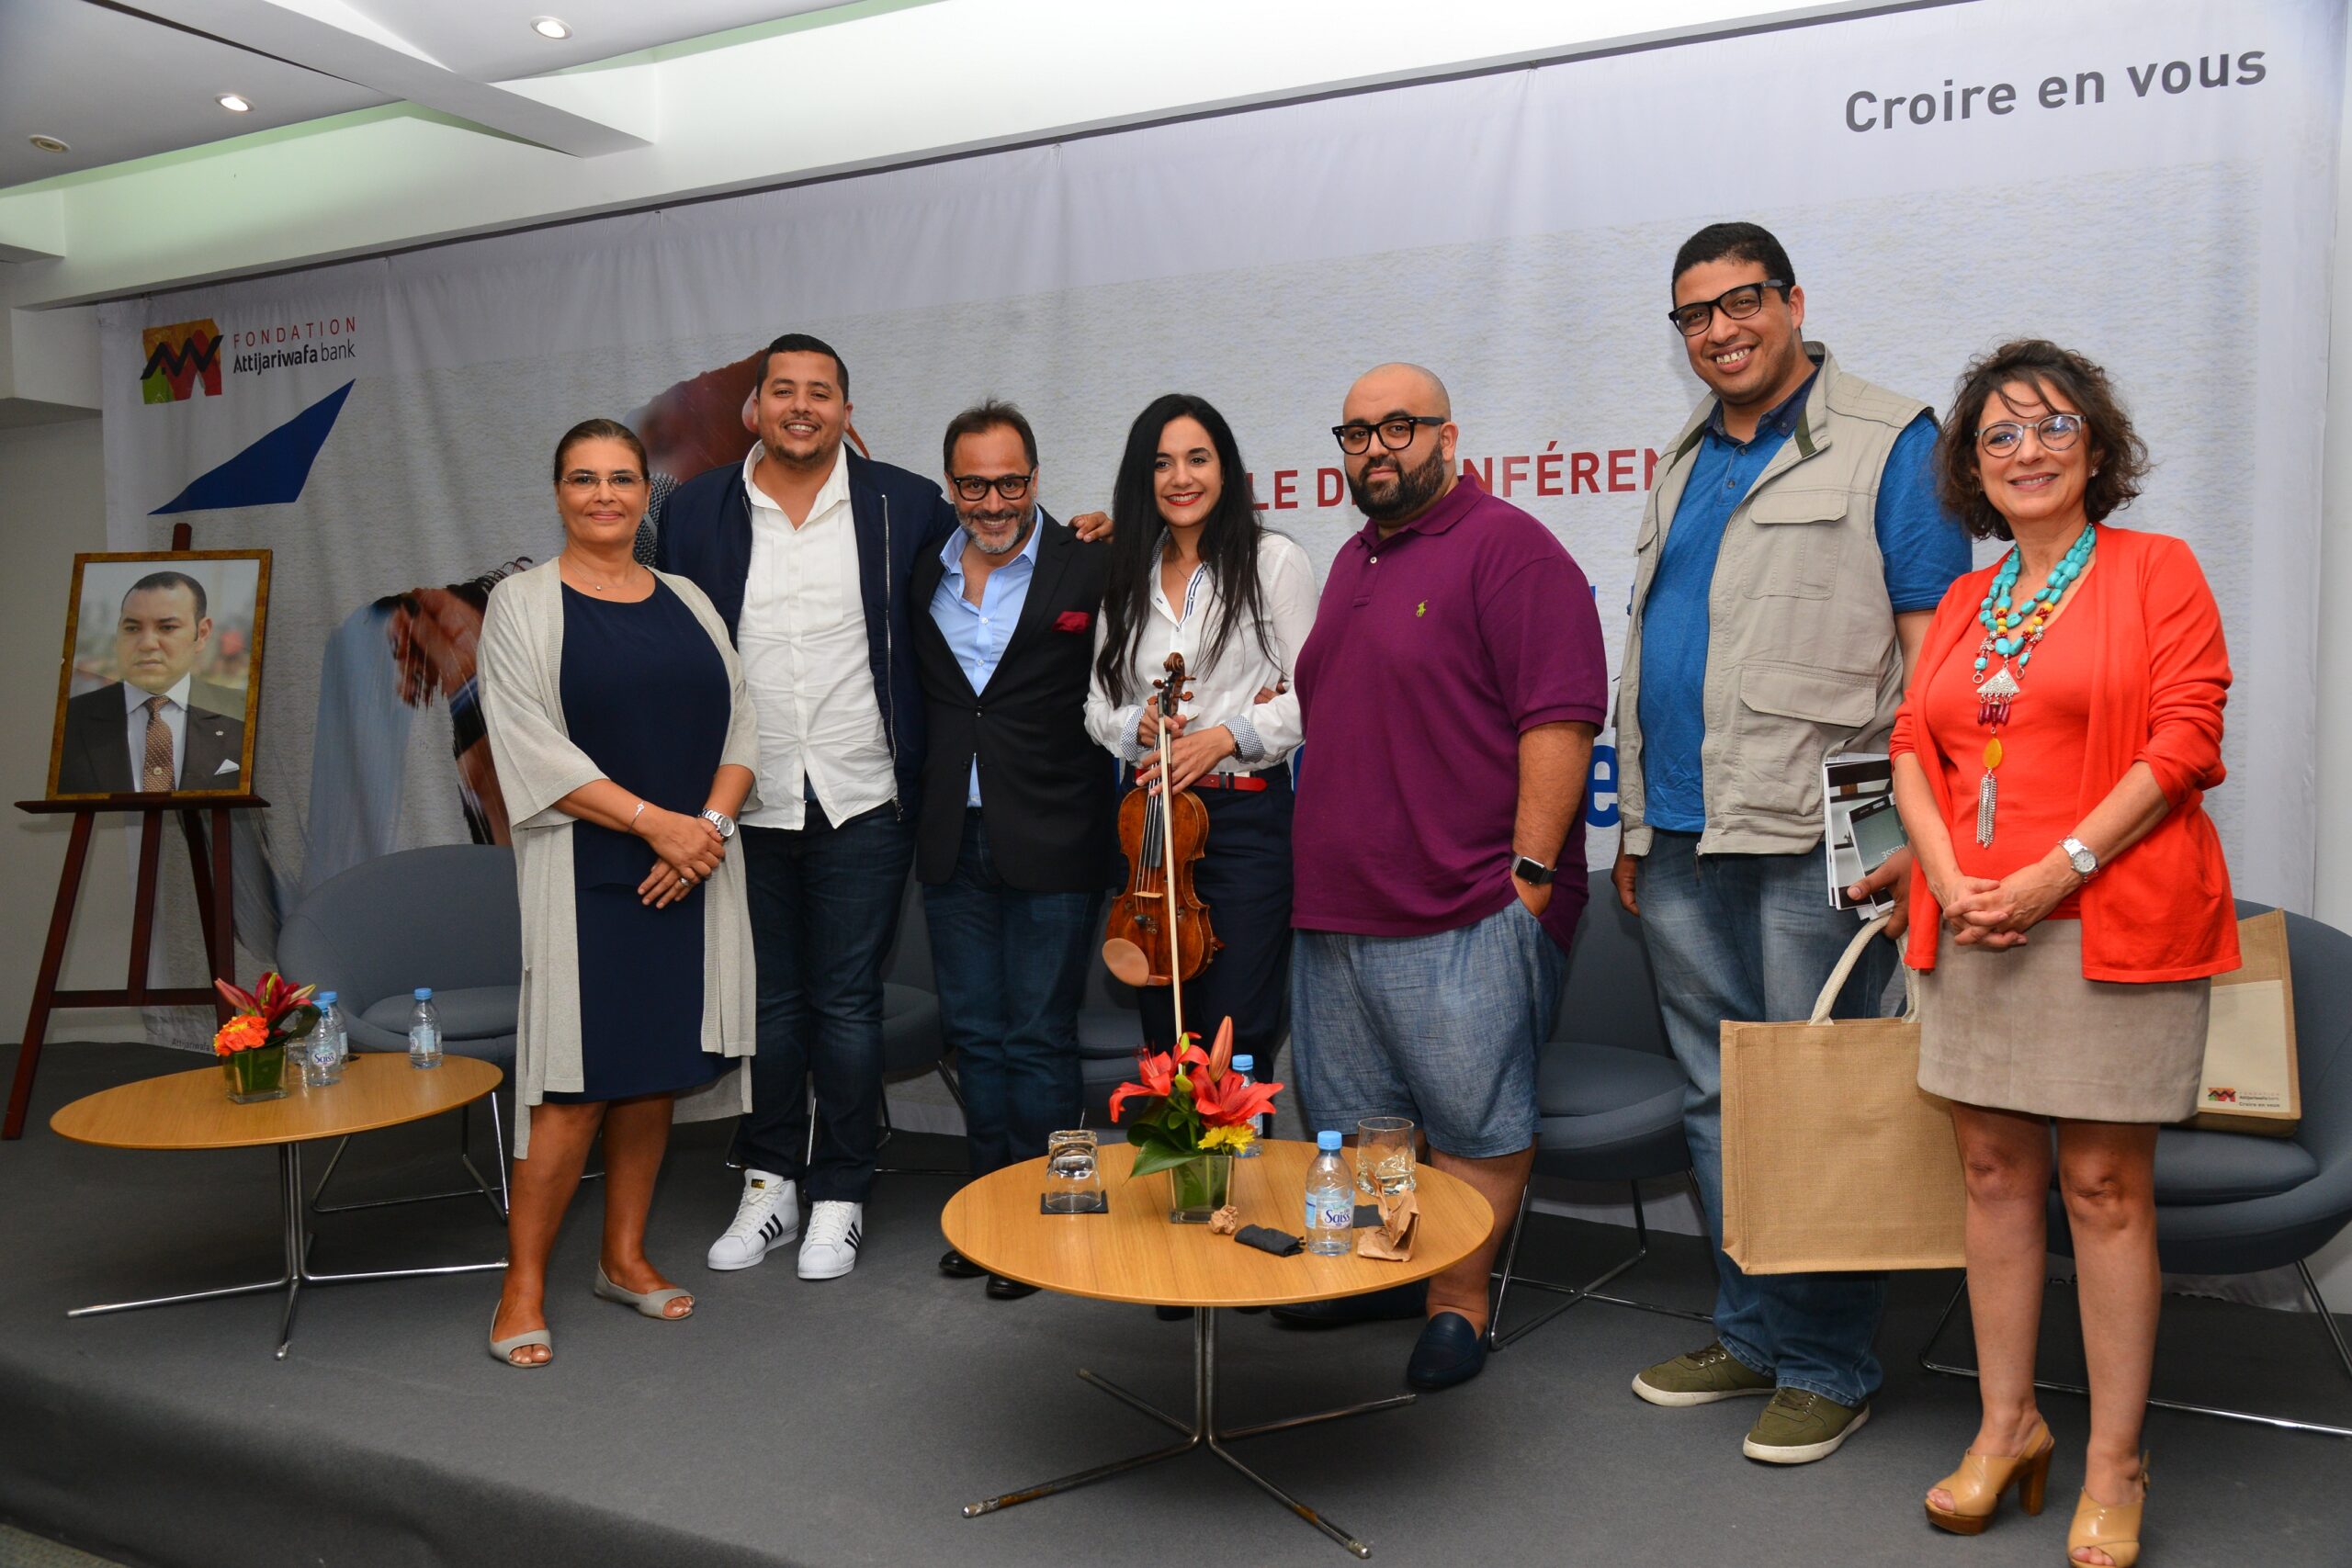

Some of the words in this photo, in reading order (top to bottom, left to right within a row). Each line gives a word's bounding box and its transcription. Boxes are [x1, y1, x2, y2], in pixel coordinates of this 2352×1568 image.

[1845, 78, 2017, 133] Croire
[2037, 69, 2105, 109] en
[2125, 50, 2267, 98] vous
[232, 316, 356, 350] FONDATION
[232, 344, 319, 376] Attijariwafa
[320, 337, 356, 362] bank
